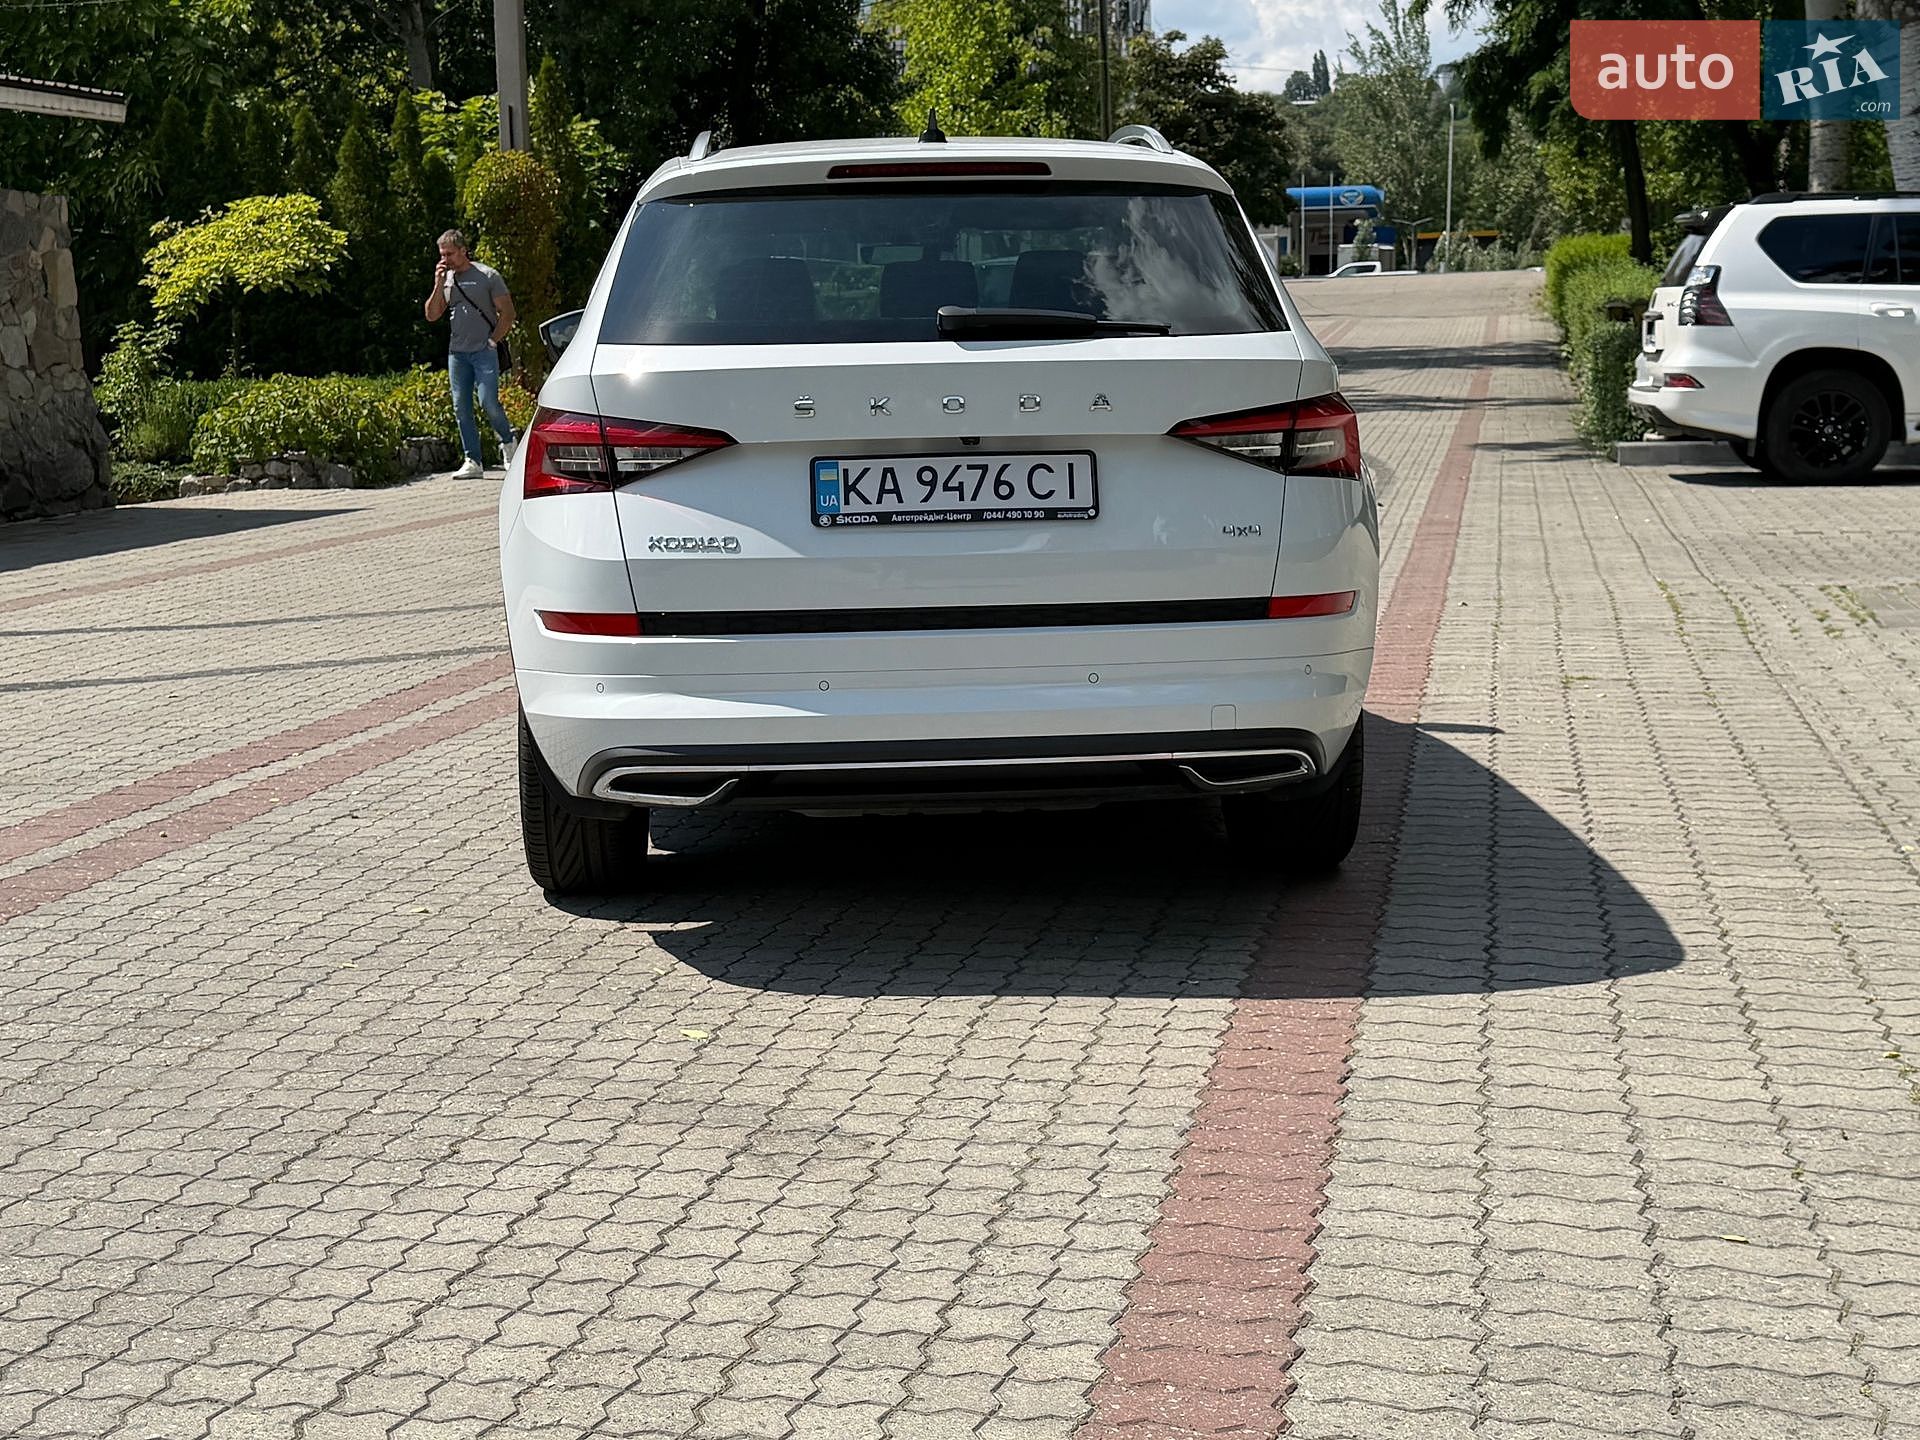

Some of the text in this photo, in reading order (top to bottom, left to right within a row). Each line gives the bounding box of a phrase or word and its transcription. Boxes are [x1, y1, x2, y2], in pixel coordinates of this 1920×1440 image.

[843, 462, 1075, 506] KA 9476 CI
[820, 495, 838, 507] UA
[1006, 510, 1022, 519] 490
[1023, 510, 1033, 518] 10
[1034, 510, 1045, 518] 90
